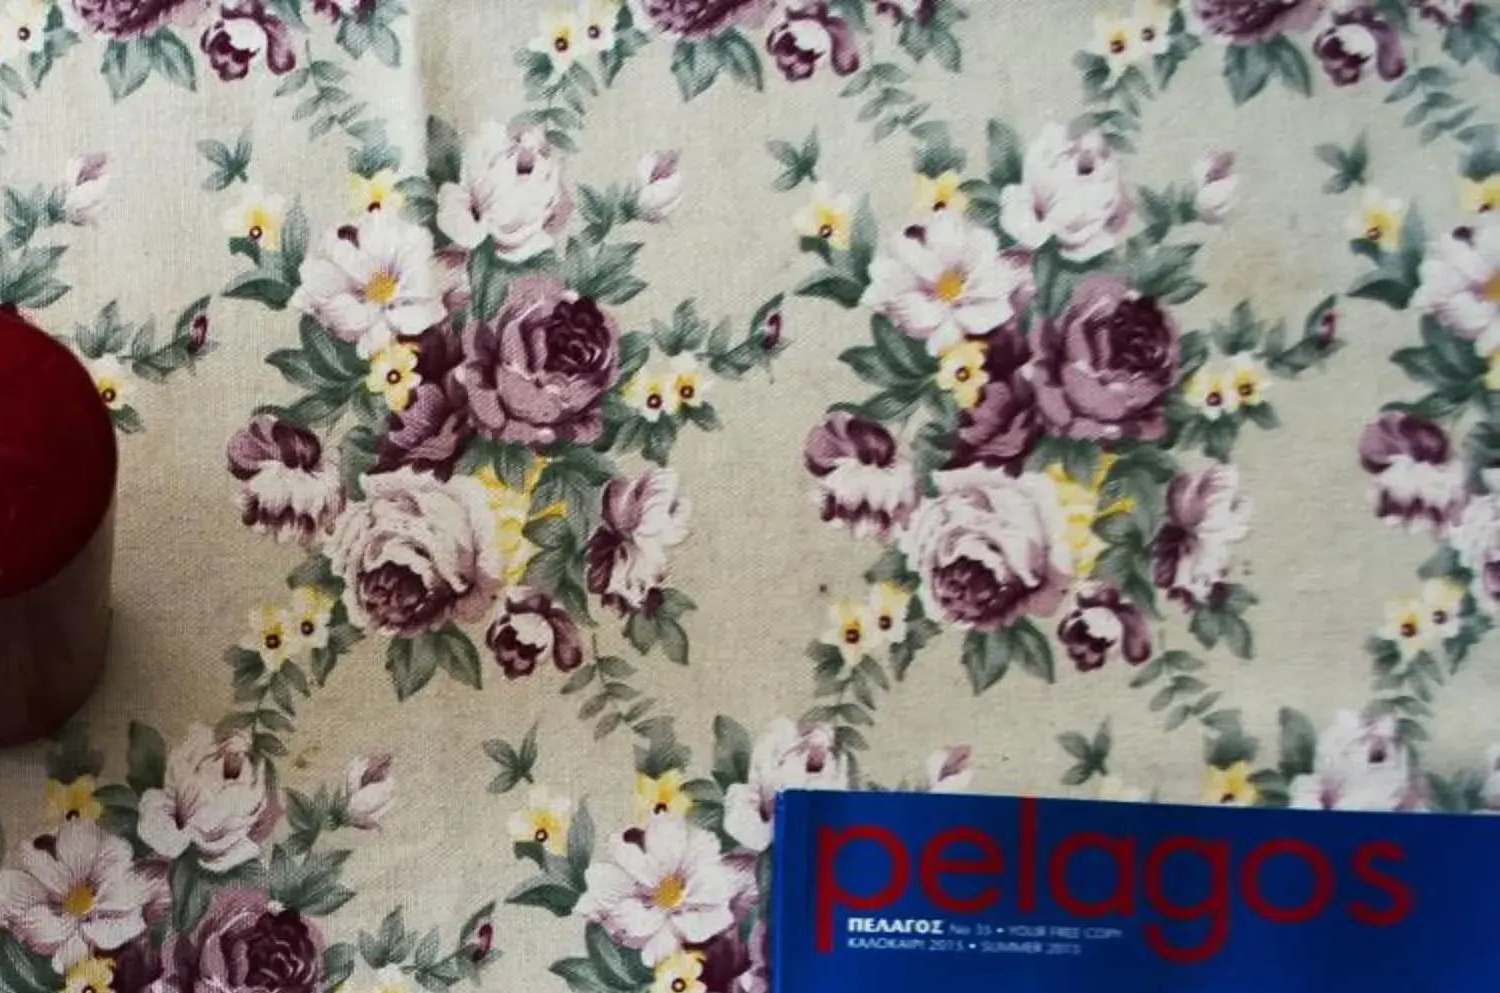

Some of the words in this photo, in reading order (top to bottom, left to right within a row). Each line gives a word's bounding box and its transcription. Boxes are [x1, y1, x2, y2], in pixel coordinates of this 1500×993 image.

[816, 796, 1413, 963] pelagos
[847, 917, 944, 934] ΠΕΛΑΓΟΣ
[1008, 924, 1046, 937] YOUR
[1050, 925, 1080, 939] FREE
[1083, 926, 1124, 939] COPY
[980, 940, 1043, 954] SUMMER
